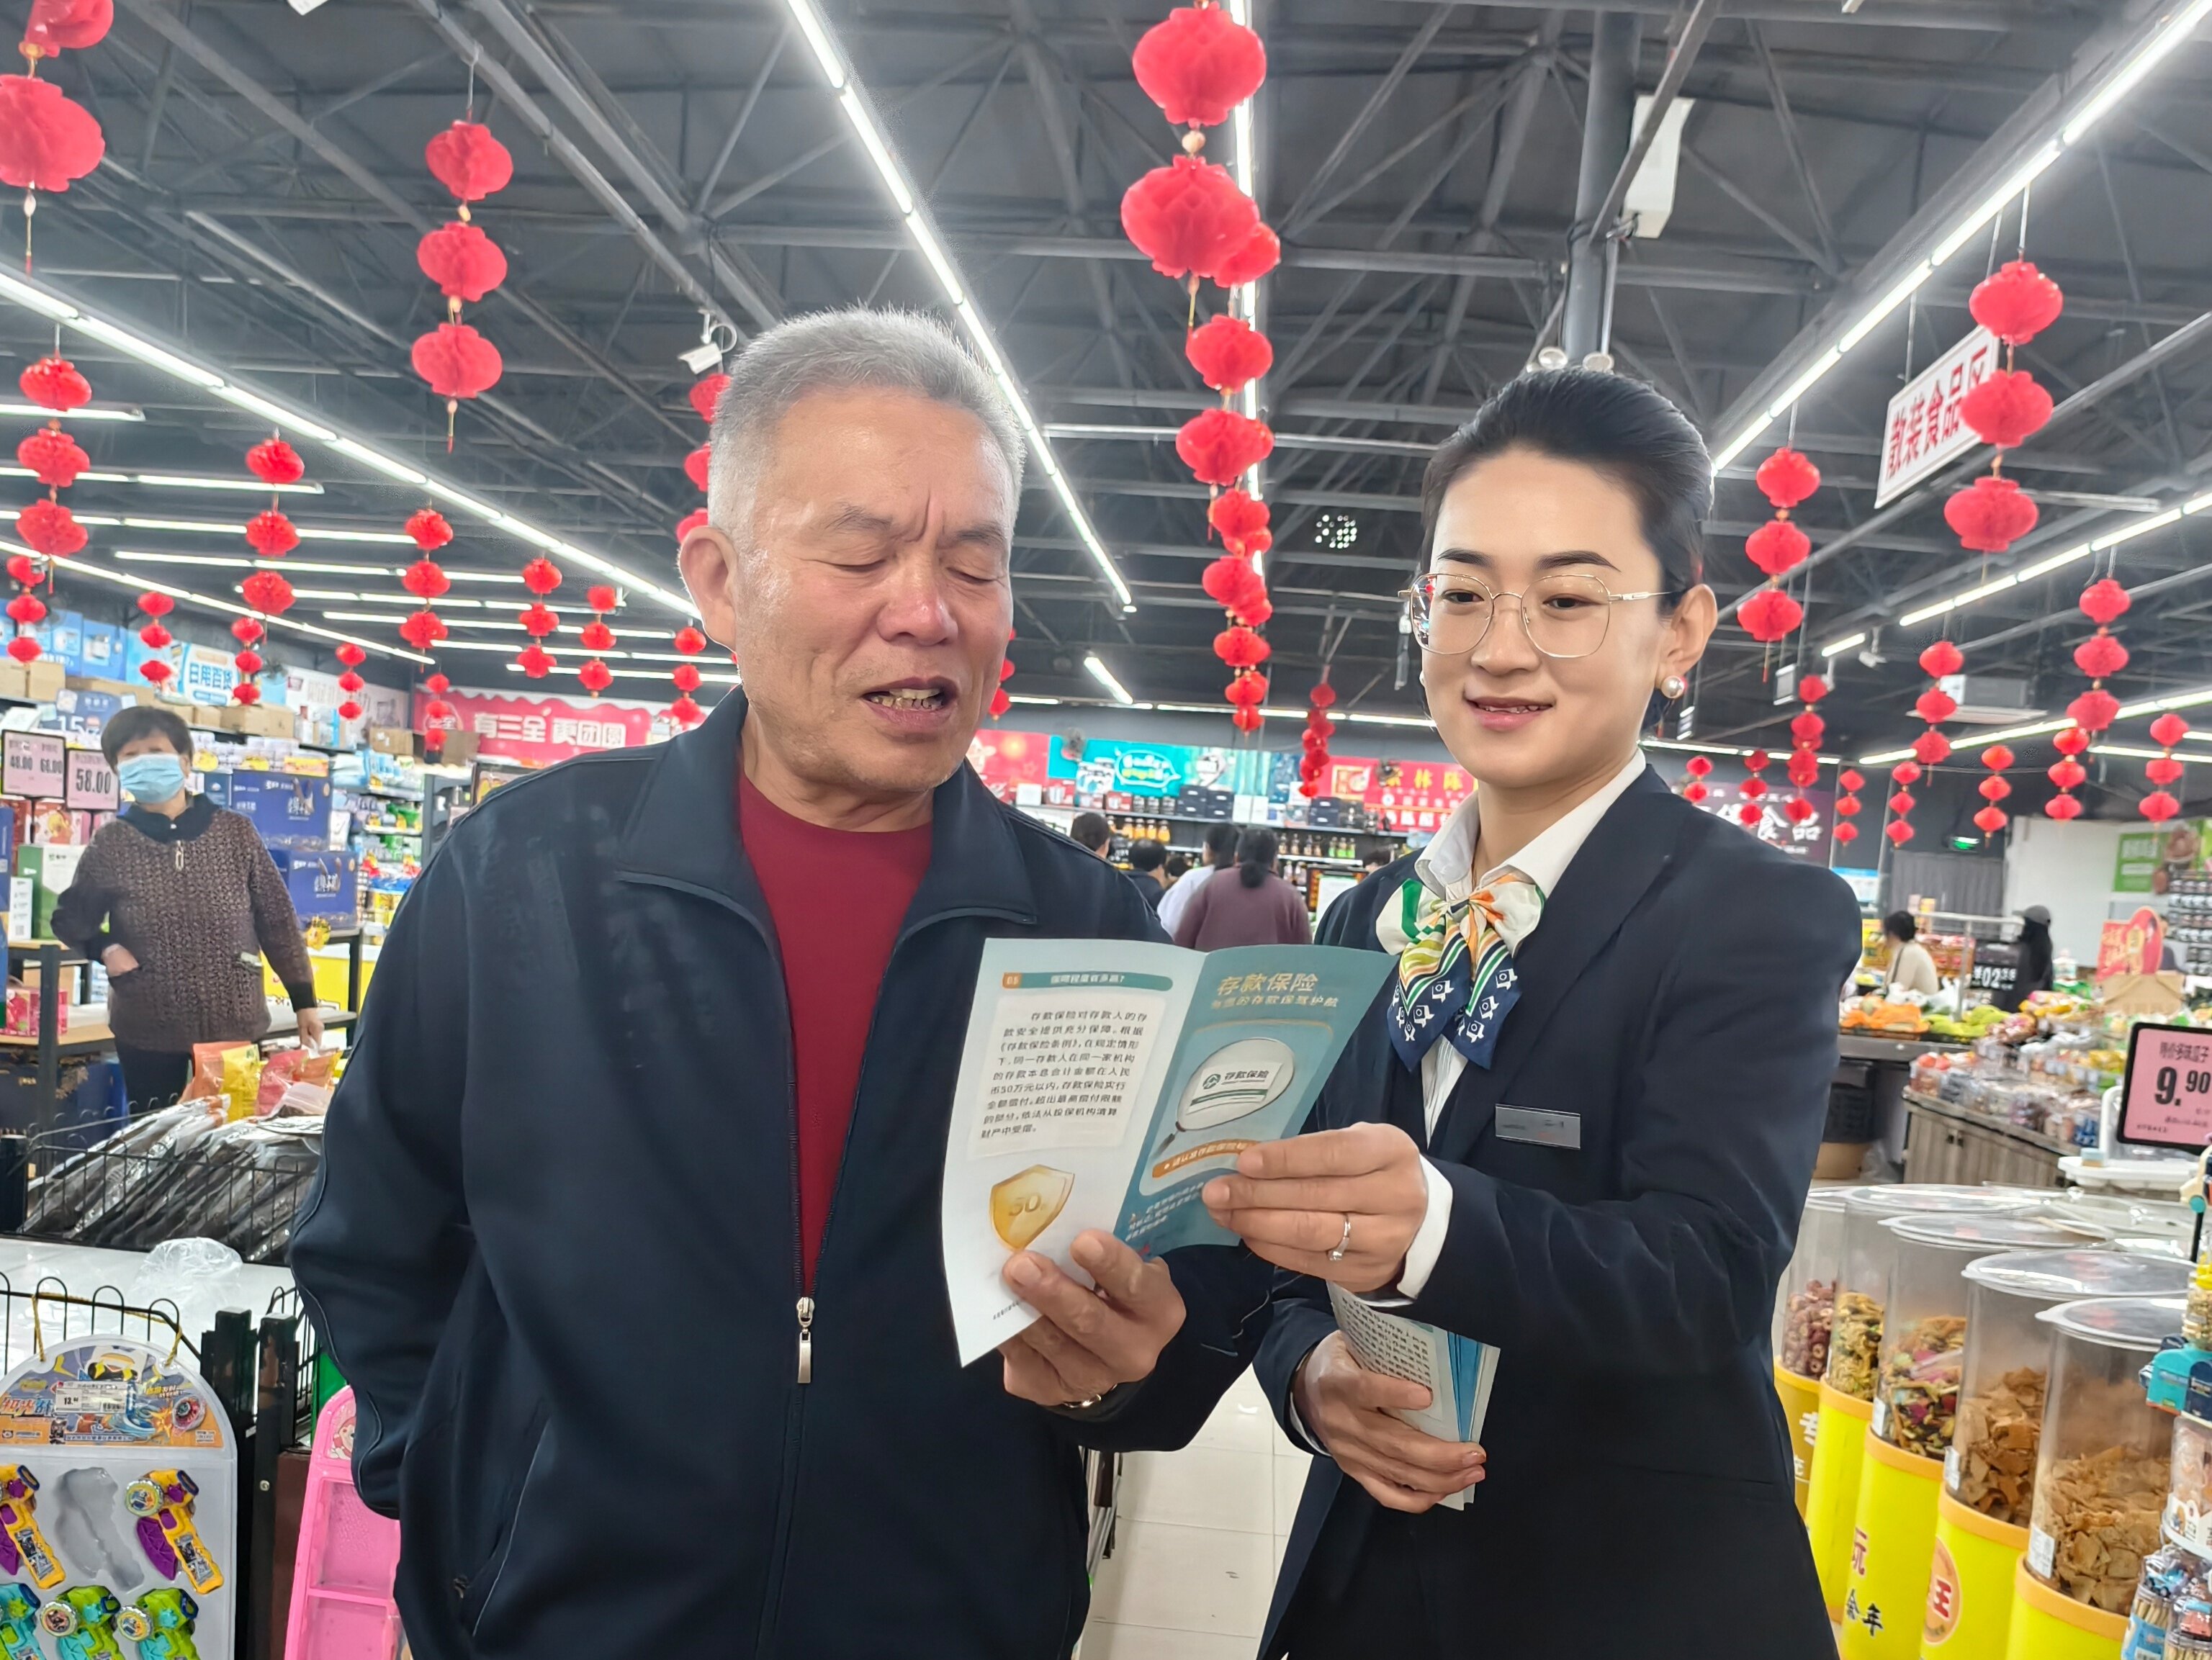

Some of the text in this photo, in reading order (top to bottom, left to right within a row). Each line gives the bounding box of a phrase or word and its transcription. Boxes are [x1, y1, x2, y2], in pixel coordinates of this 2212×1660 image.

[189, 662, 233, 690] 日用百货
[76, 768, 112, 795] 58.00
[1217, 973, 1318, 996] 存款保险
[1224, 1070, 1269, 1081] 存款保险
